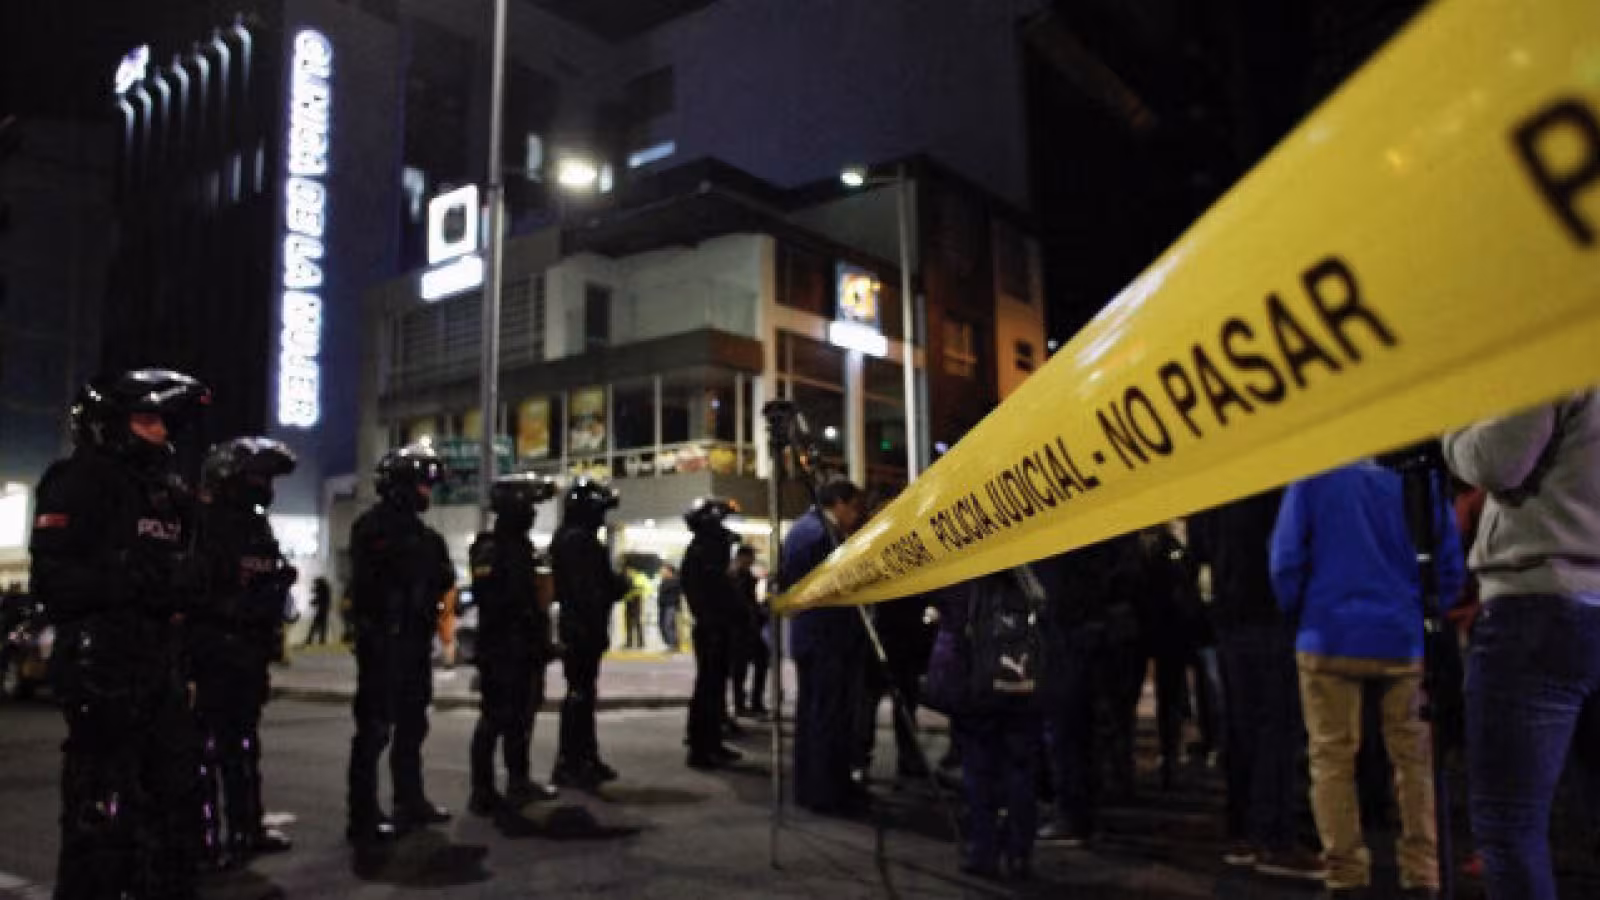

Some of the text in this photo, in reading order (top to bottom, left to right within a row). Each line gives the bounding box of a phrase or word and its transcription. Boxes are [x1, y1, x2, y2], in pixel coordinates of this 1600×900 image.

[930, 491, 999, 552] POLICIA
[985, 436, 1100, 528] JUDICIAL
[1096, 386, 1174, 470] NO
[1158, 256, 1399, 438] PASAR
